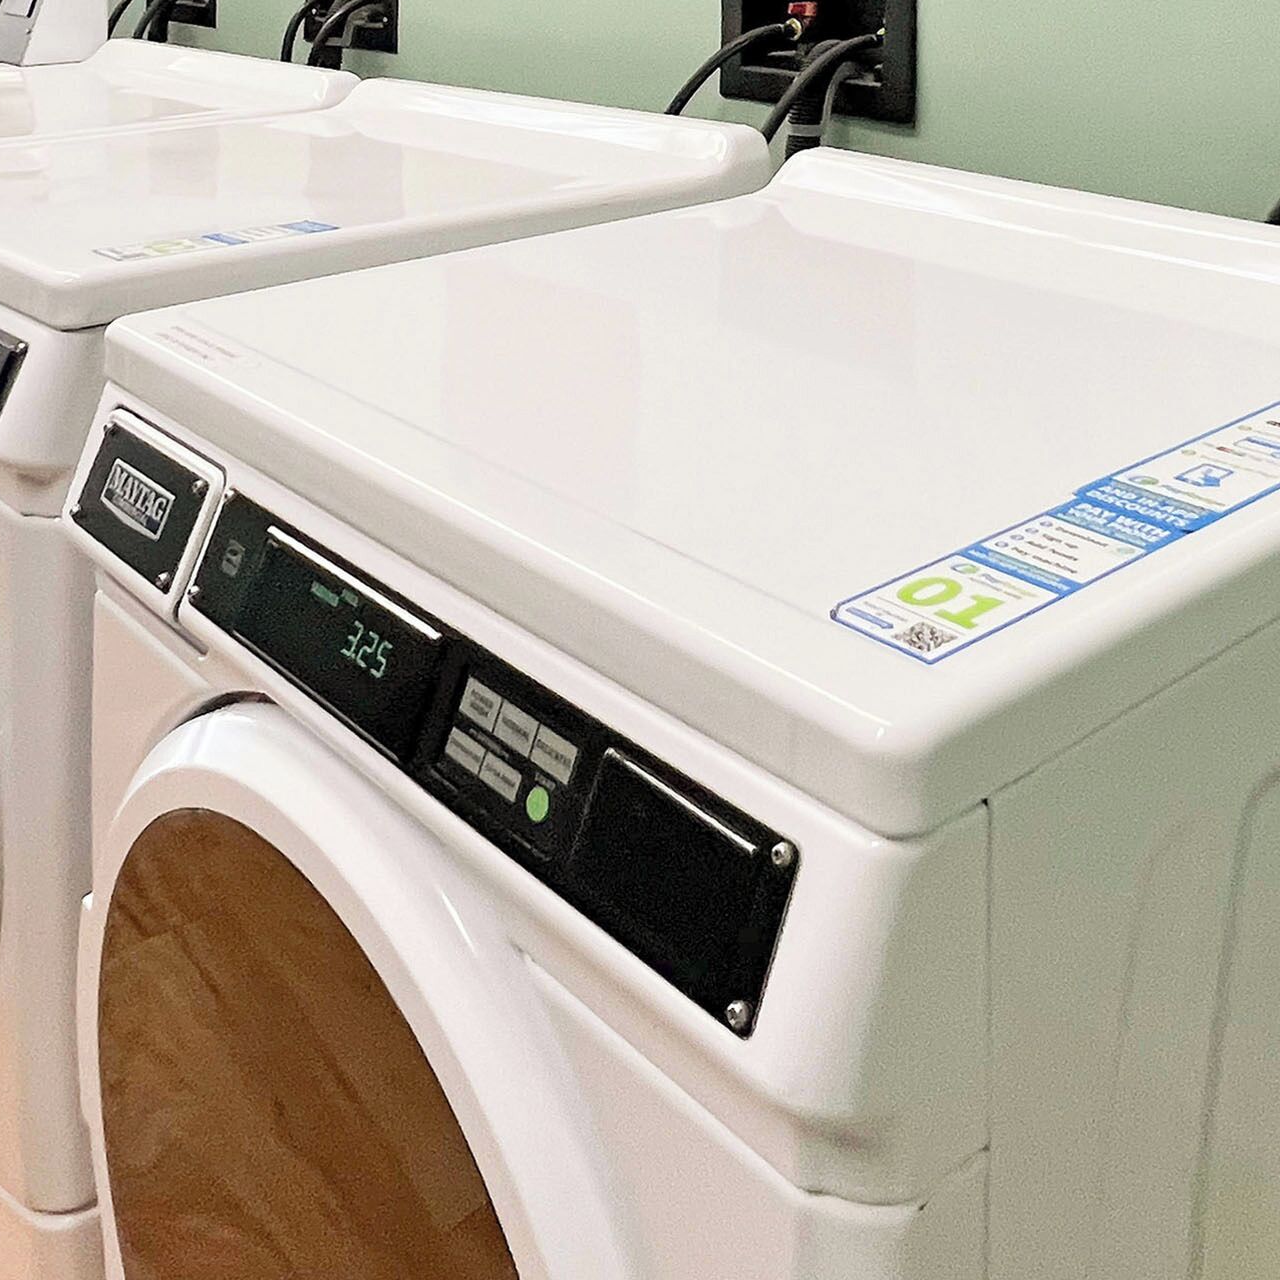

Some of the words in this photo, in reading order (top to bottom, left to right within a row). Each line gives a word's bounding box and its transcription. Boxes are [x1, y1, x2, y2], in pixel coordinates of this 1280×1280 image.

[109, 466, 168, 521] MAYTAG
[1086, 489, 1189, 527] DISCOUNTS
[1074, 503, 1117, 519] PAY
[1114, 515, 1171, 538] WITH
[896, 577, 1006, 629] 01
[340, 620, 393, 678] 3.25
